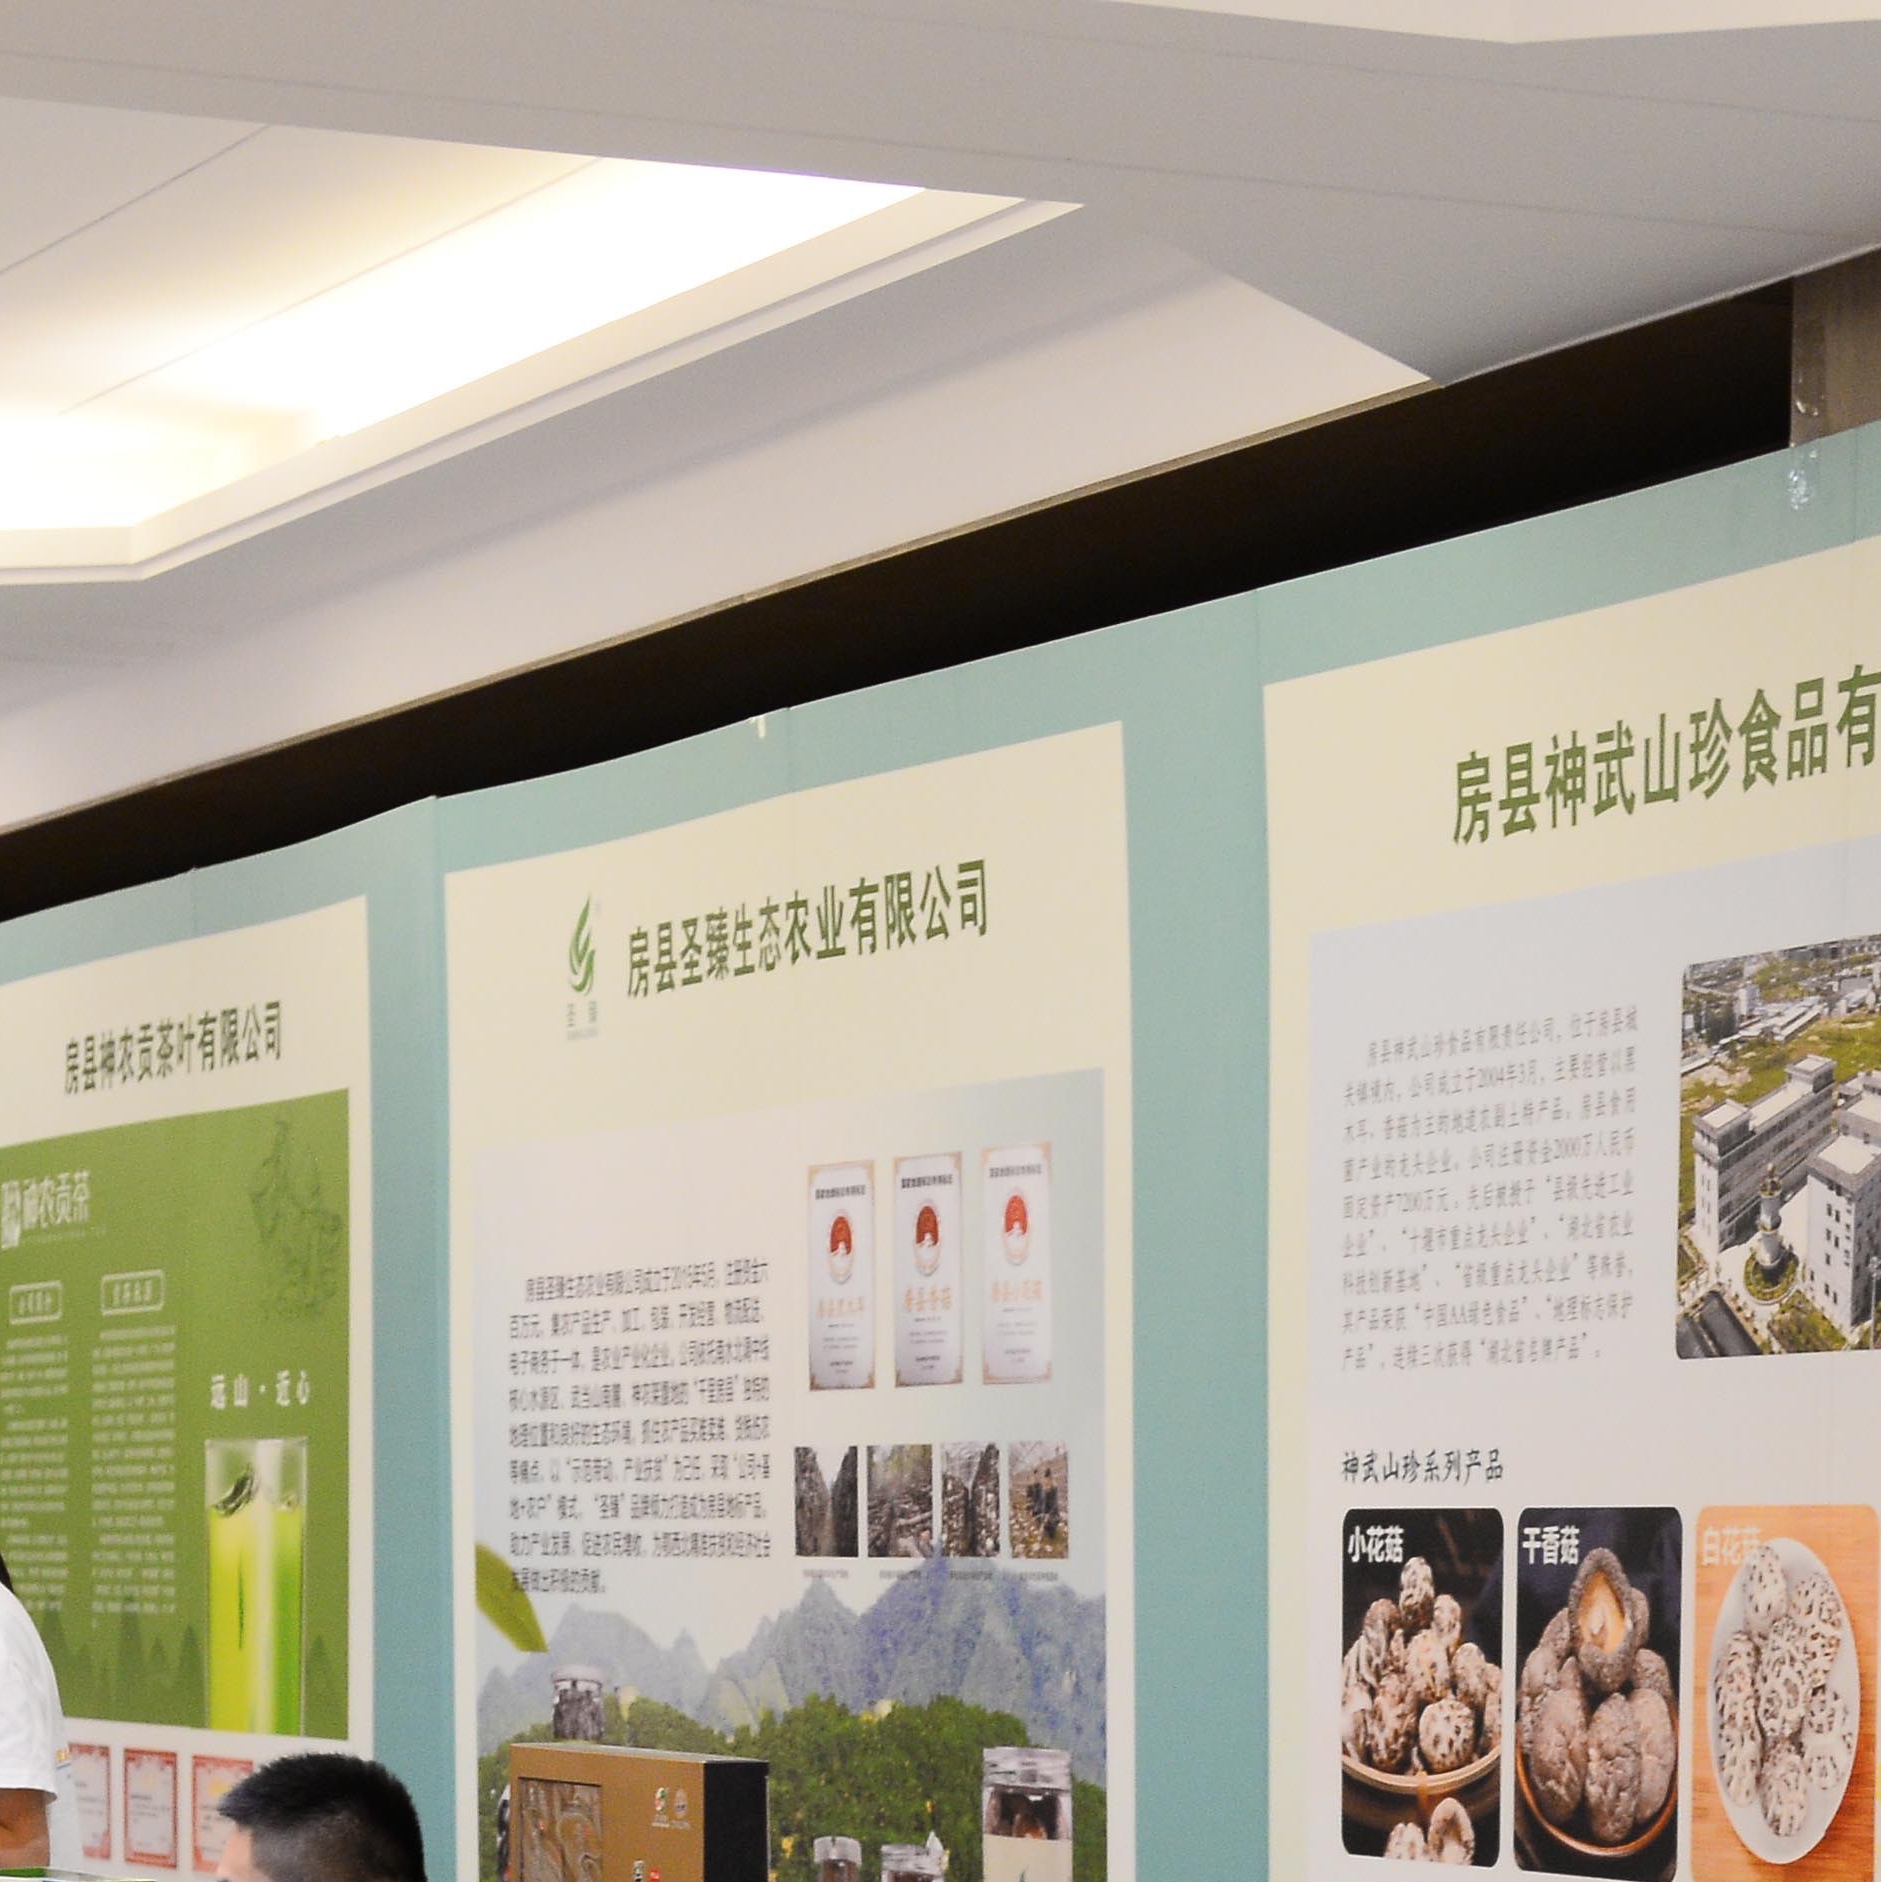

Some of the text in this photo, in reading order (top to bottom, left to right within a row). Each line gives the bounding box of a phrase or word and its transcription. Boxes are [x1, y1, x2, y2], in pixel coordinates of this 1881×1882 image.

[627, 859, 988, 998] 房县圣臻生态农业有限公司
[66, 1000, 281, 1094] 房县神农贡茶叶有限公司
[1342, 1448, 1504, 1484] 神武山珍系列产品
[1346, 1524, 1405, 1564] 小花菇
[1521, 1524, 1581, 1567] 干香菇
[1701, 1524, 1763, 1567] 白花菇
